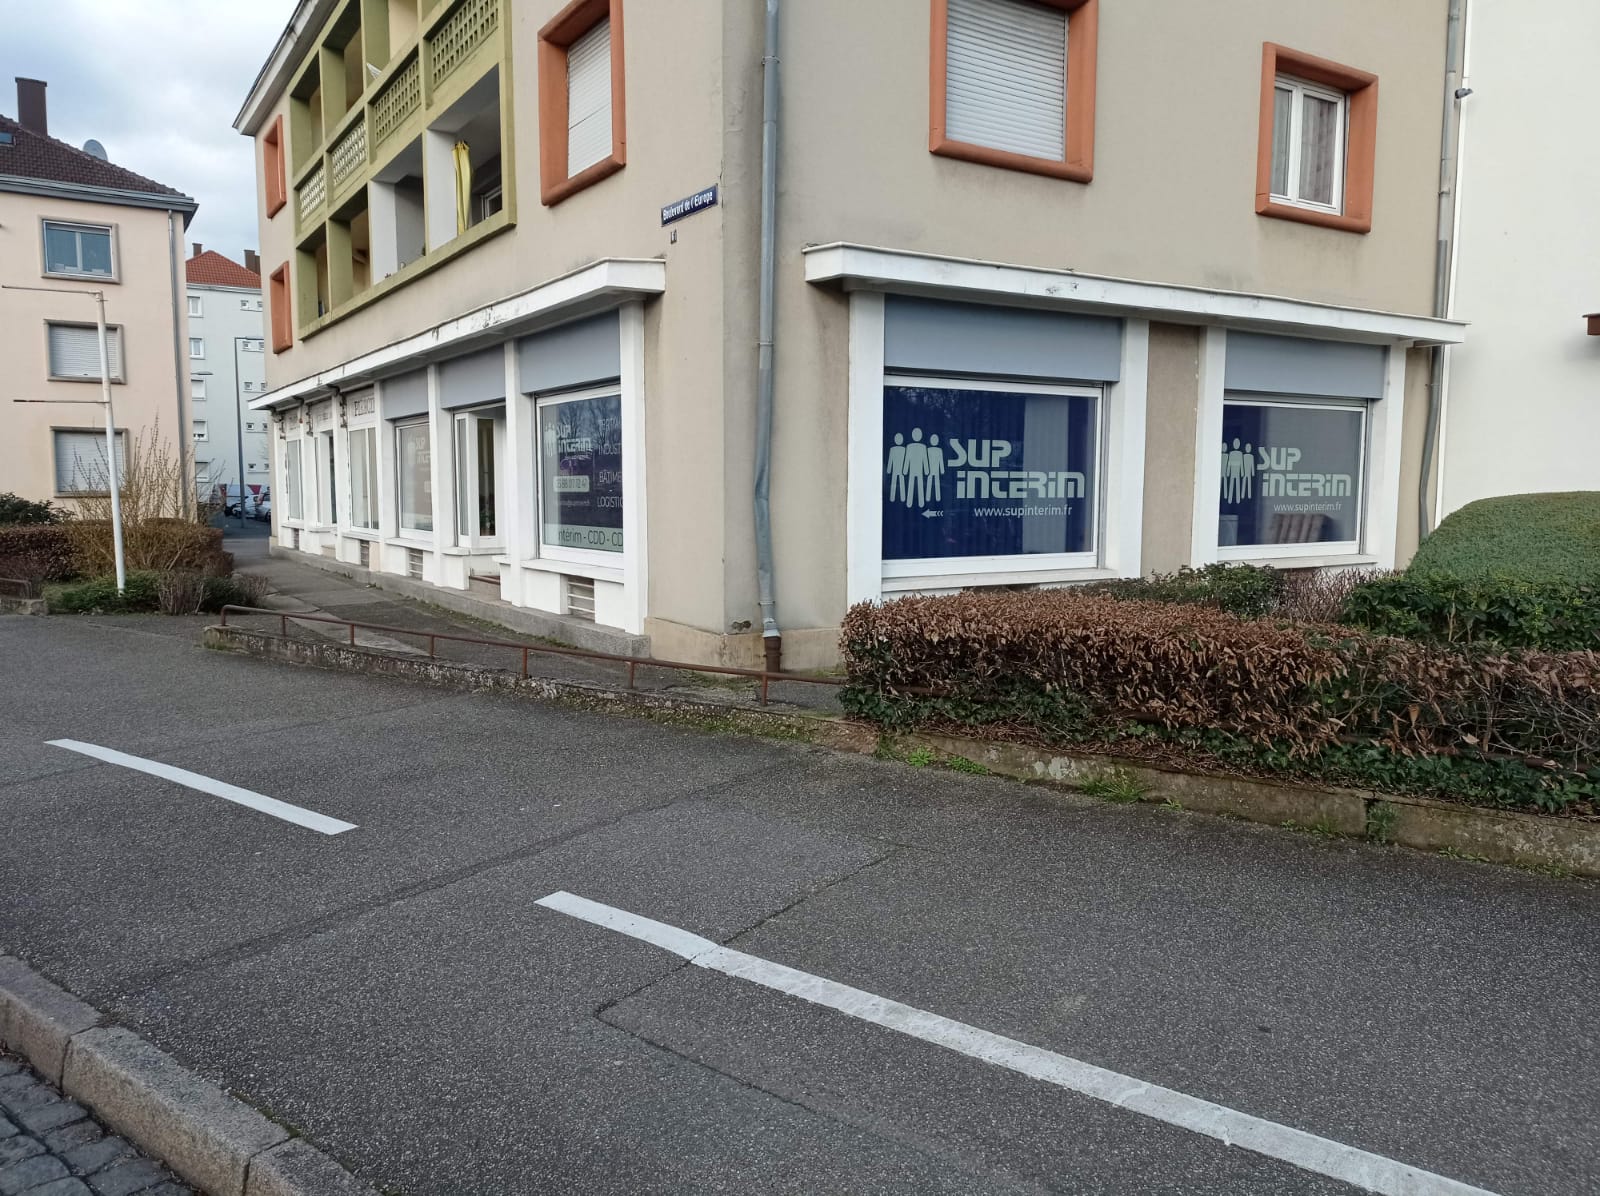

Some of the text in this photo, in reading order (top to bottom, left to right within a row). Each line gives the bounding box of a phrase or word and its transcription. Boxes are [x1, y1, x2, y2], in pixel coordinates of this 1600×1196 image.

[947, 438, 1012, 468] SUP
[1256, 446, 1302, 471] SUP
[974, 504, 1072, 518] www.supinterim.fr
[1273, 502, 1342, 513] www.supinterim.fr
[587, 530, 605, 545] CDD
